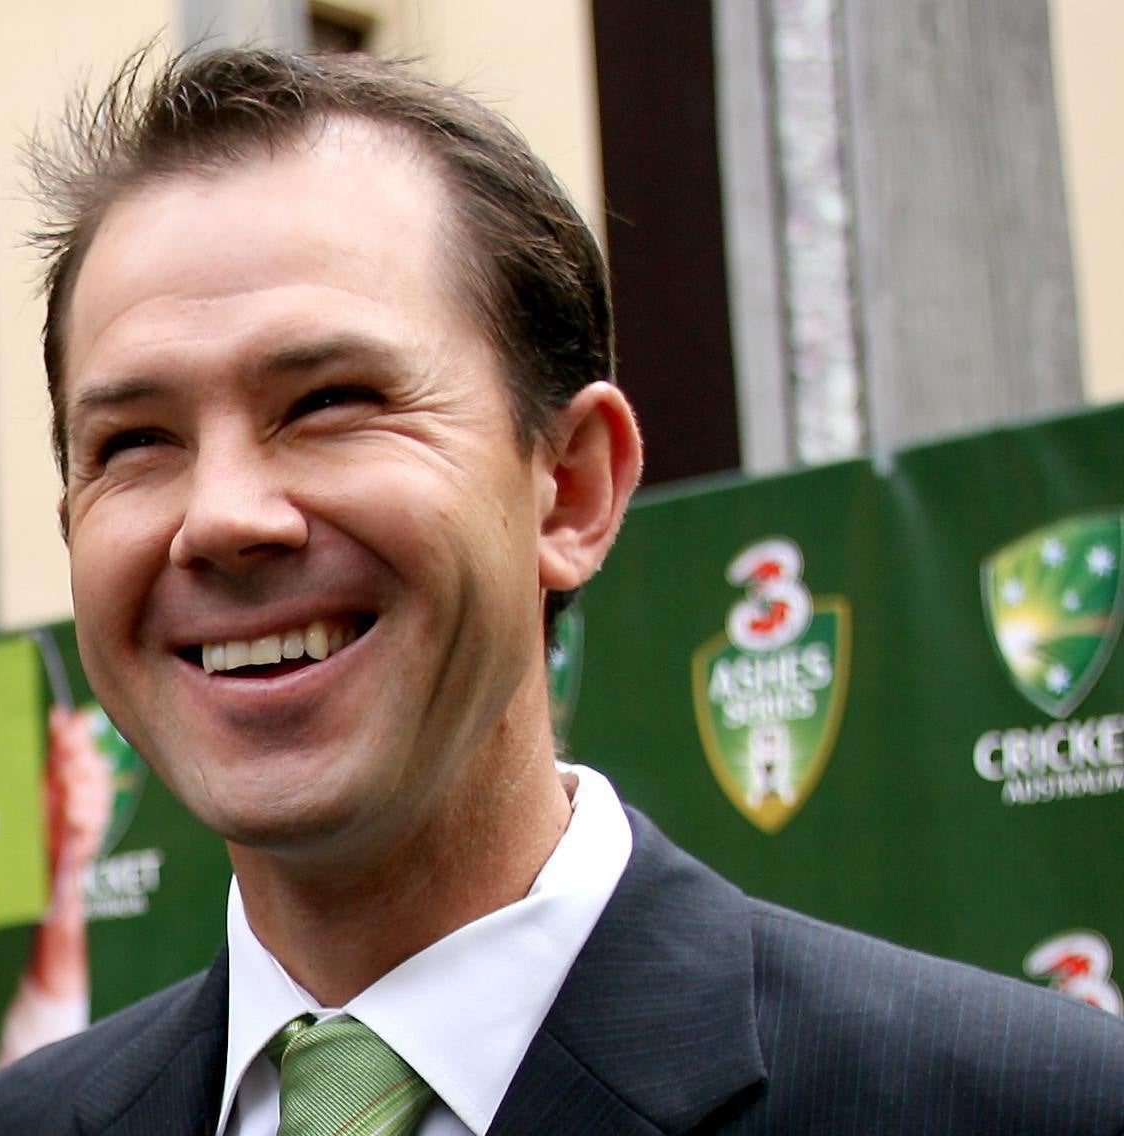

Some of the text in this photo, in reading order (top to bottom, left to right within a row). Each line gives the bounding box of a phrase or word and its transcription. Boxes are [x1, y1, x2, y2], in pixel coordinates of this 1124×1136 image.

[725, 536, 812, 652] 3
[710, 643, 832, 703] ASHES
[973, 714, 1124, 781] CRICKE
